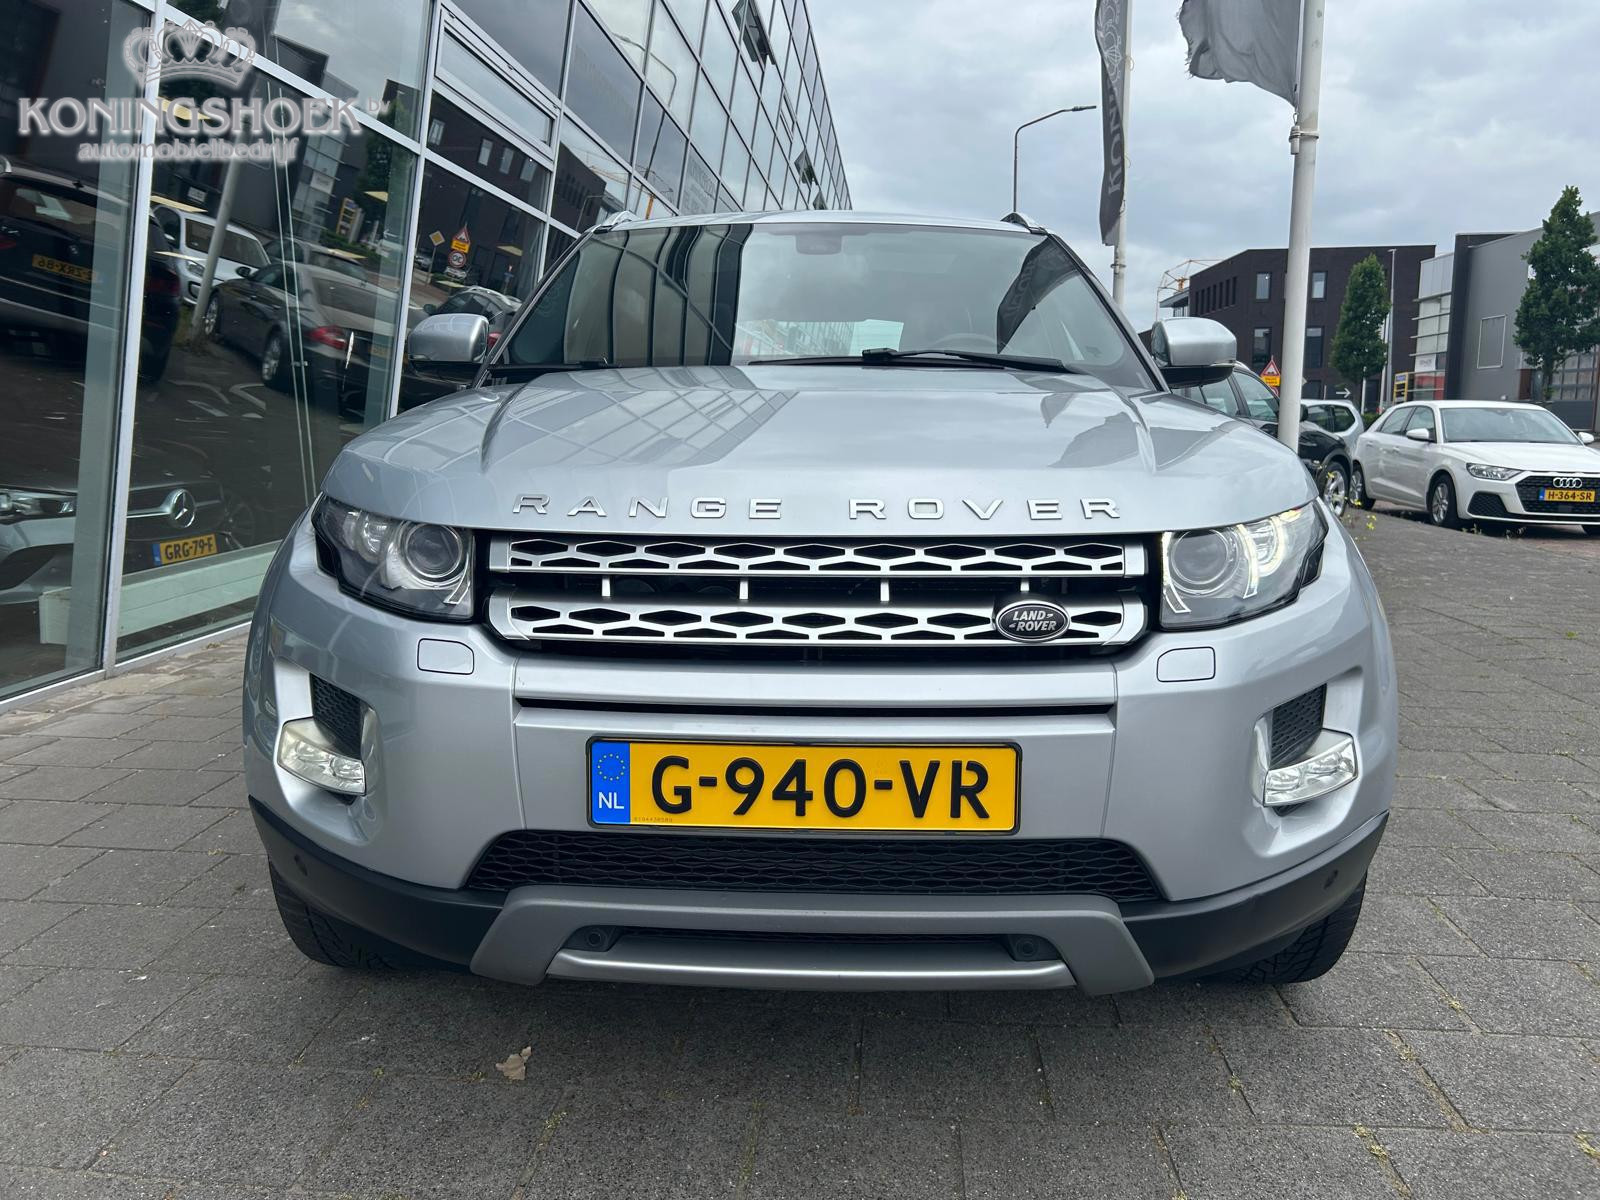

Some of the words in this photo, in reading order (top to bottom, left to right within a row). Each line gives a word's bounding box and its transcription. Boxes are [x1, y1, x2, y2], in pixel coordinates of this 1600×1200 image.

[1547, 490, 1593, 501] H-364-SR
[512, 493, 782, 519] RANGE
[849, 497, 1121, 520] ROVER
[165, 536, 213, 560] GRG-79-F
[1012, 610, 1046, 621] LAND
[1016, 620, 1057, 632] ROVER
[651, 754, 991, 819] G-940-VR
[598, 791, 625, 810] NL
